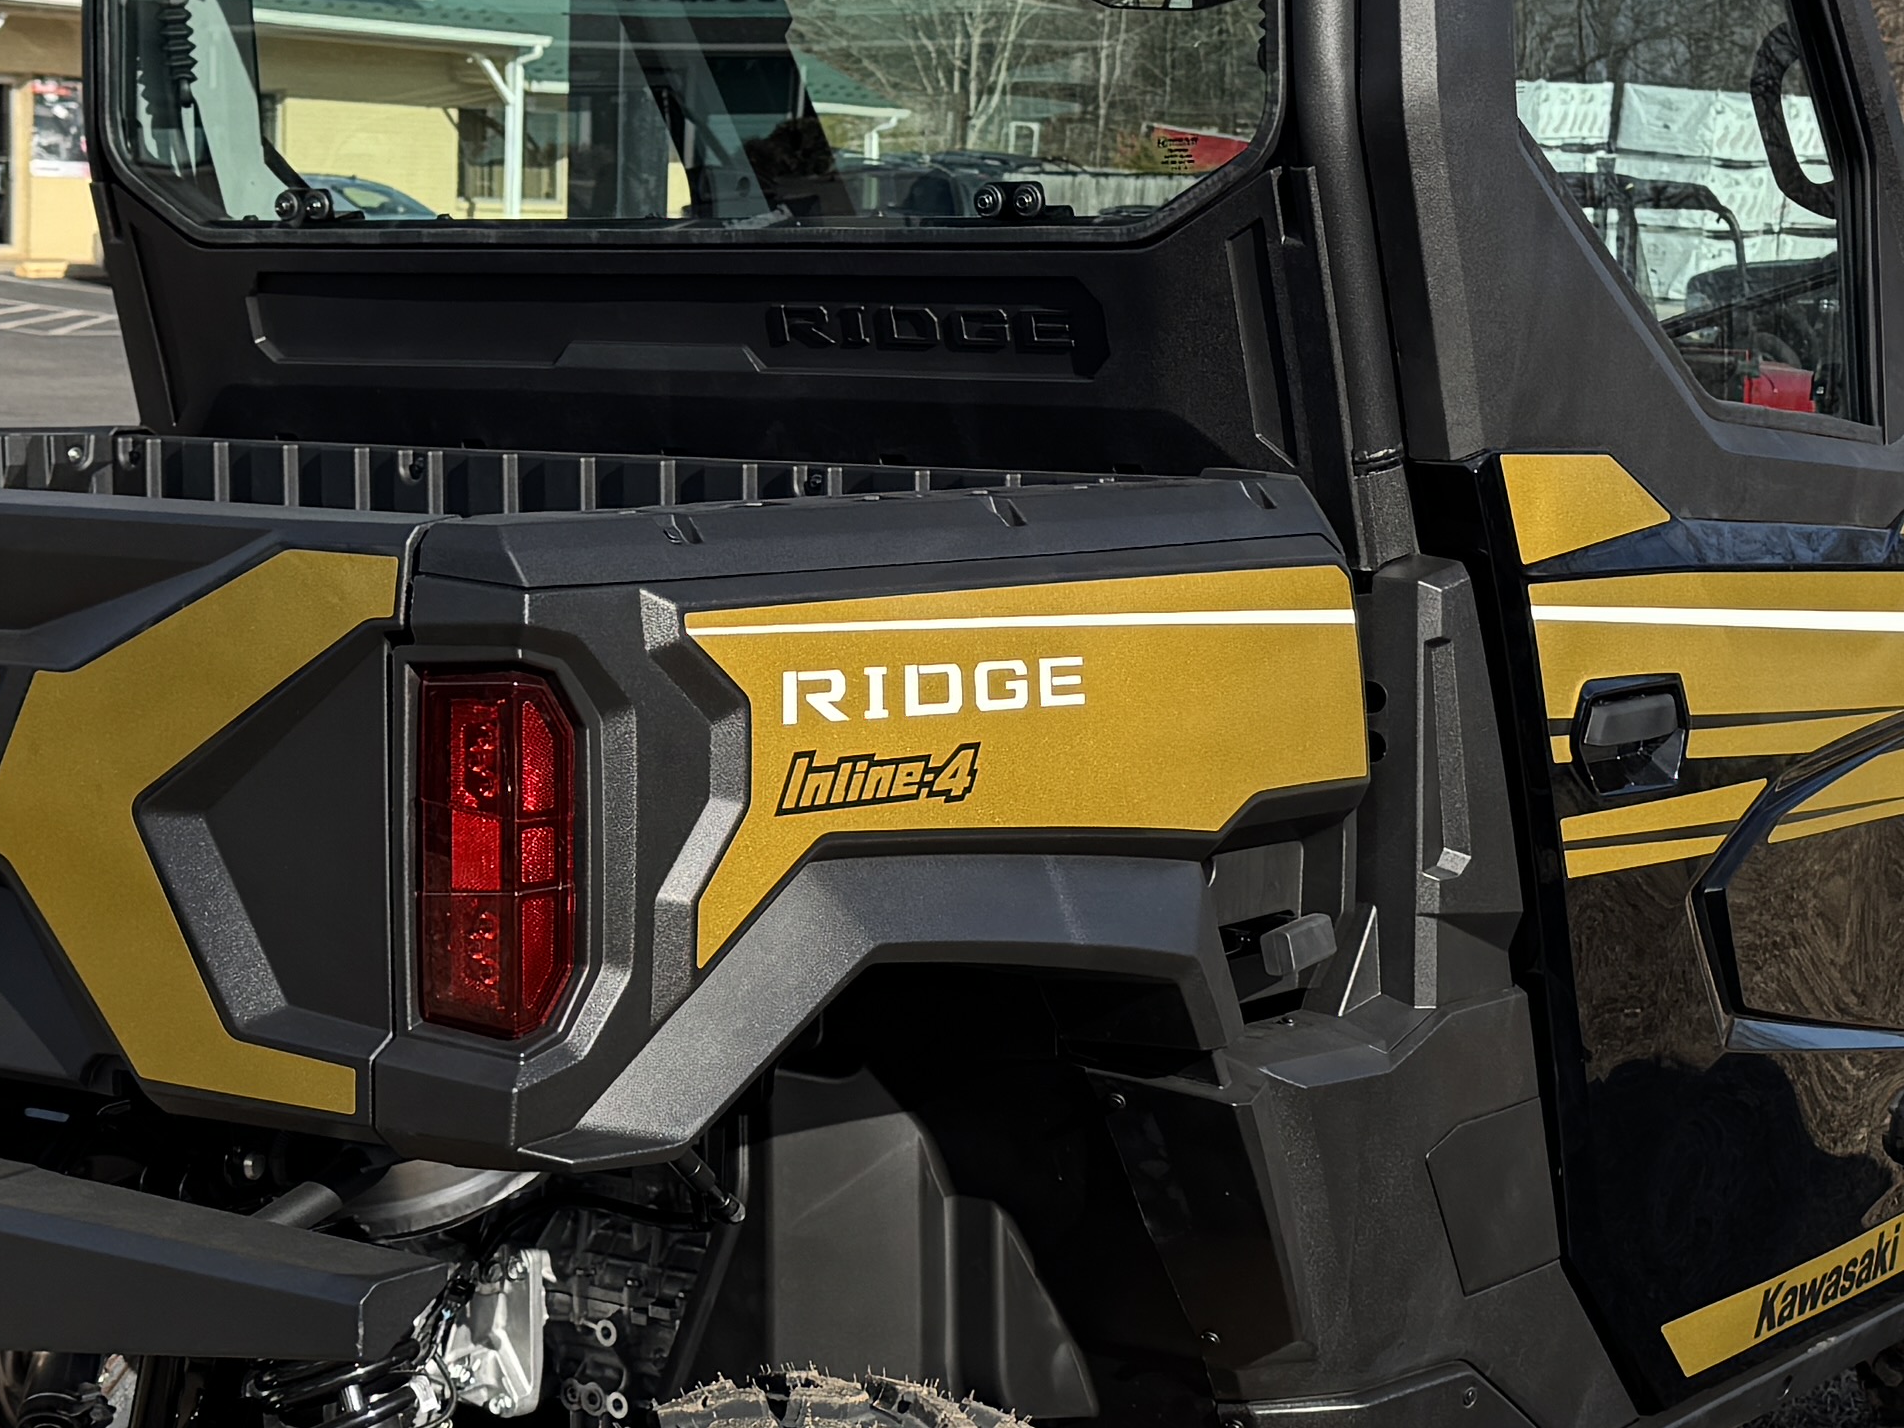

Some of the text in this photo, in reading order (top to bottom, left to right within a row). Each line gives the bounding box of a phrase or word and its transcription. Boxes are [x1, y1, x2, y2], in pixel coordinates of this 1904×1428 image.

[764, 302, 1079, 356] RIDGE
[782, 655, 1086, 726] RIDGE
[774, 741, 982, 817] Inline-4
[1753, 1221, 1902, 1339] Kawasaki
